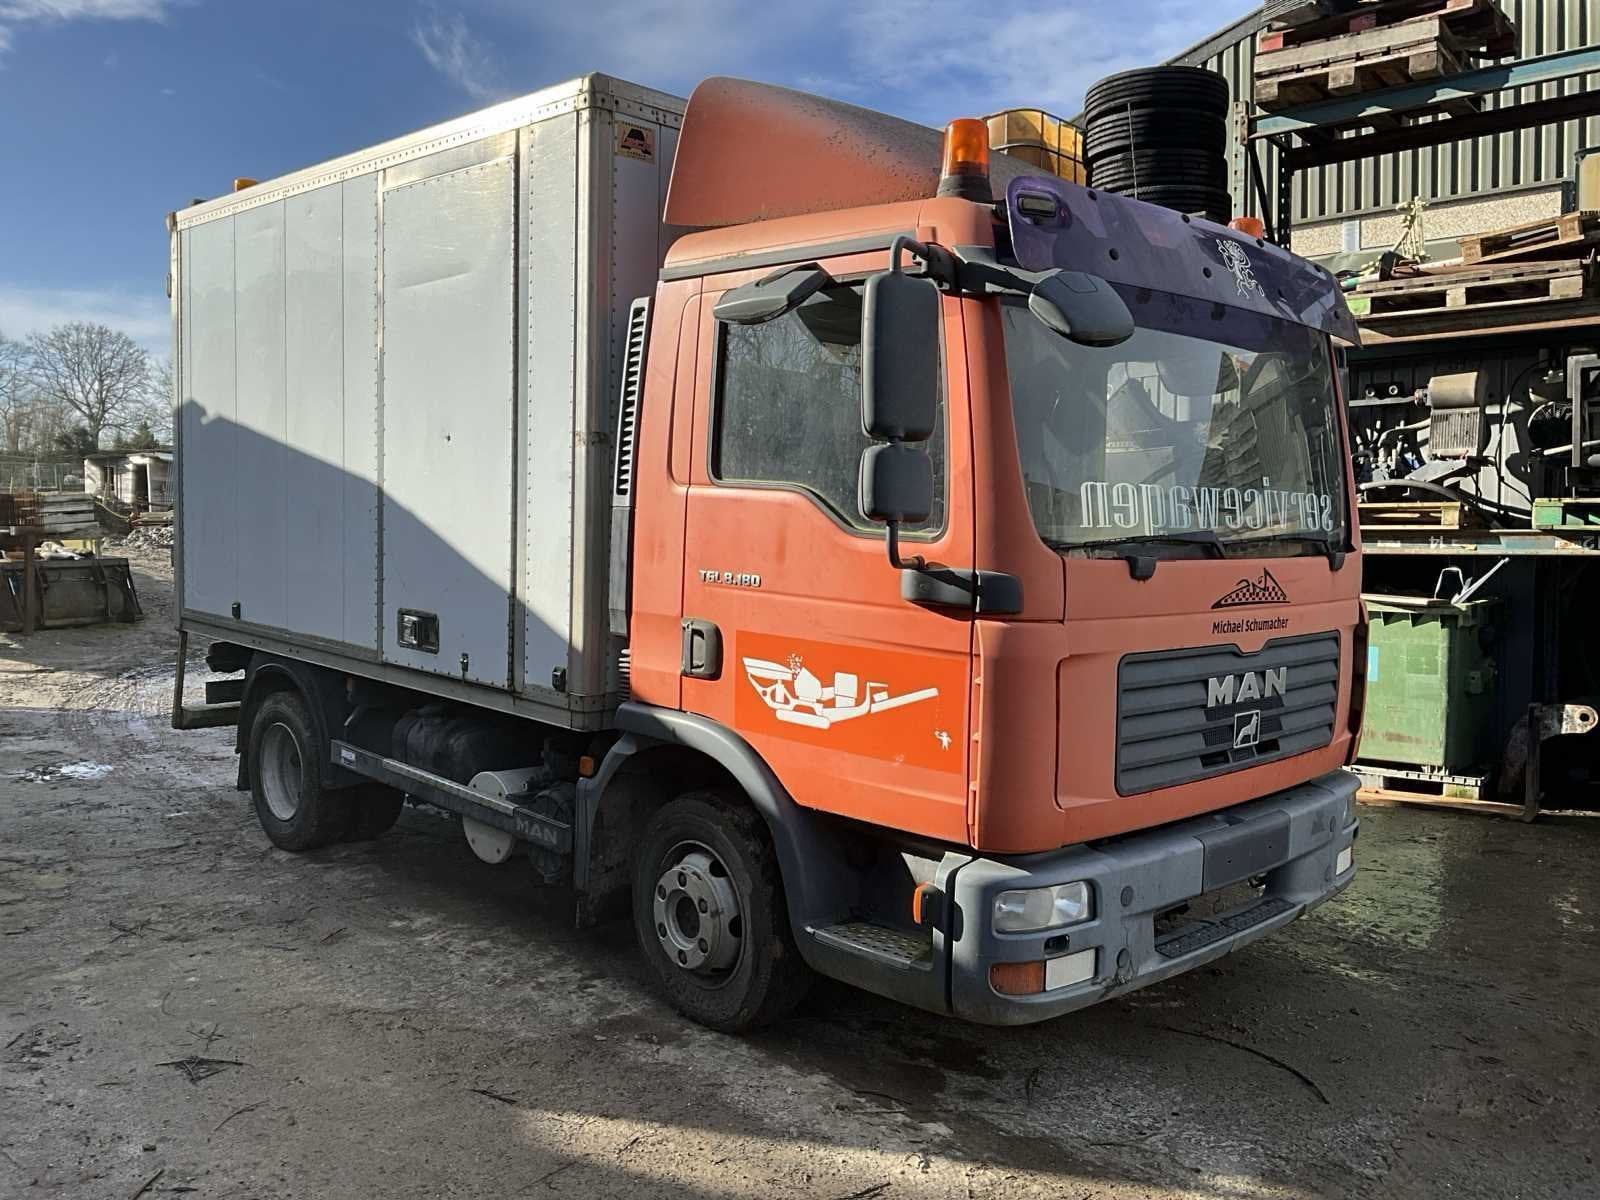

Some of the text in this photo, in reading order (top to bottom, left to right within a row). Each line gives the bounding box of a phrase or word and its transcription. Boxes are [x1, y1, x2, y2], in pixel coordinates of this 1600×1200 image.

[699, 569, 761, 587] TGL 8.180
[1211, 616, 1289, 635] Michael Schumacher
[1207, 666, 1288, 708] MAN
[517, 817, 557, 844] MAN
